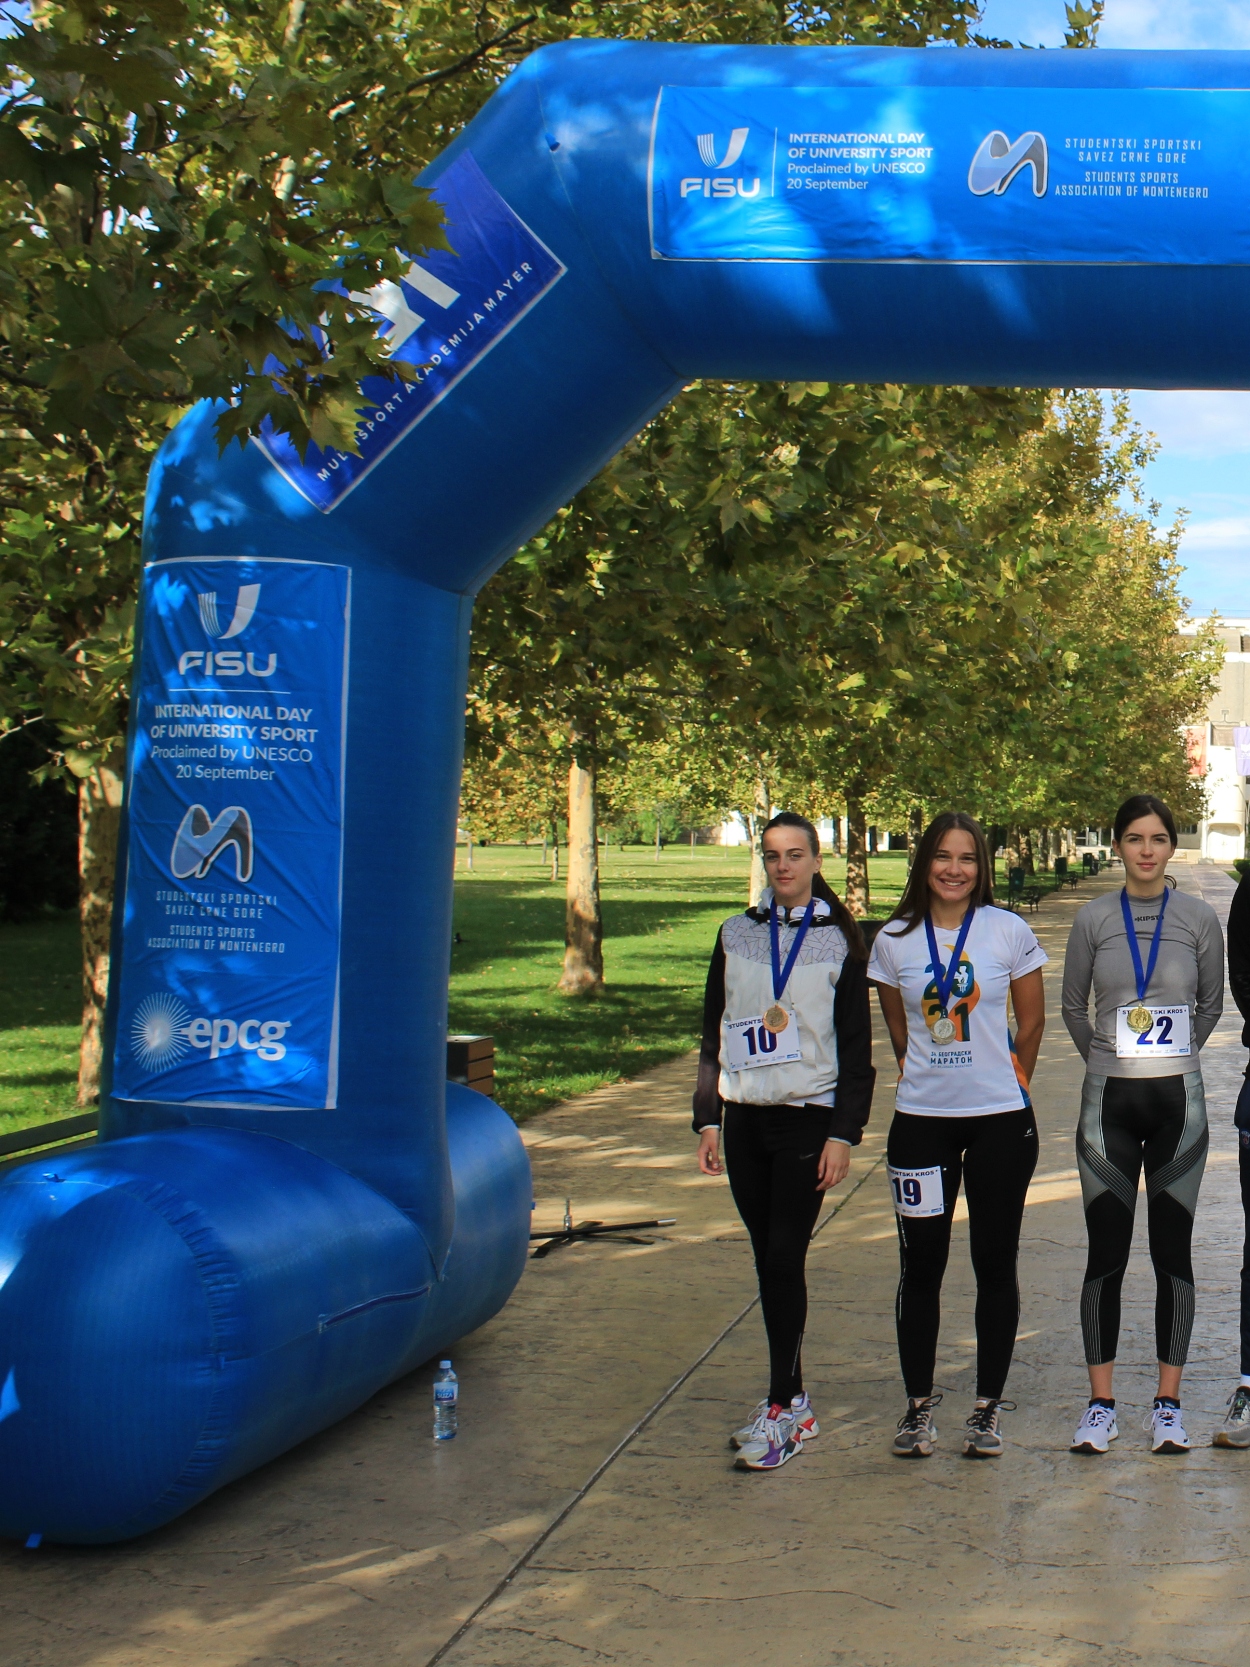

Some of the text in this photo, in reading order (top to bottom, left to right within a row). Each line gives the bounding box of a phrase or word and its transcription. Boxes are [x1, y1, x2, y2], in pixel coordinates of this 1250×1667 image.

[789, 133, 925, 143] INTERNATIONAL DAY
[1065, 138, 1201, 150] STUDENTSKI SPORTSKI
[788, 148, 933, 158] OF UNIVERSITY SPORT
[1078, 151, 1186, 163] SAVEZ CRNE GORE
[788, 163, 926, 176] Proclaimed by UNESCO
[1085, 171, 1178, 183] STUDENTS SPORTS
[680, 178, 760, 198] FISU
[787, 178, 868, 191] 20 September
[1055, 185, 1209, 198] ASSOCIATION OF MONTENEGRO
[317, 393, 403, 481] MULISPORT
[483, 262, 532, 312] MAYER
[178, 651, 277, 677] FISU
[155, 704, 313, 722] INTERNATIONAL DAY
[150, 724, 318, 743] OF UNIVERSITY SPORT
[151, 745, 313, 763] Proclaimed by UNESCO
[176, 765, 275, 781] 20 September
[156, 891, 277, 906] STUDENTSKI SPORTSKI
[165, 905, 263, 919] SAVEZ CRNE GORE
[170, 925, 255, 939] STUDENTS SPORTS
[147, 938, 285, 953] ASSOCIATION OF MONTENEGRO
[727, 1018, 764, 1029] STUDENTS
[1137, 1016, 1173, 1045] 22
[189, 1017, 291, 1061] epcg
[742, 1025, 777, 1056] 10
[930, 1056, 972, 1065] МАРАТОН
[892, 1177, 922, 1207] 19
